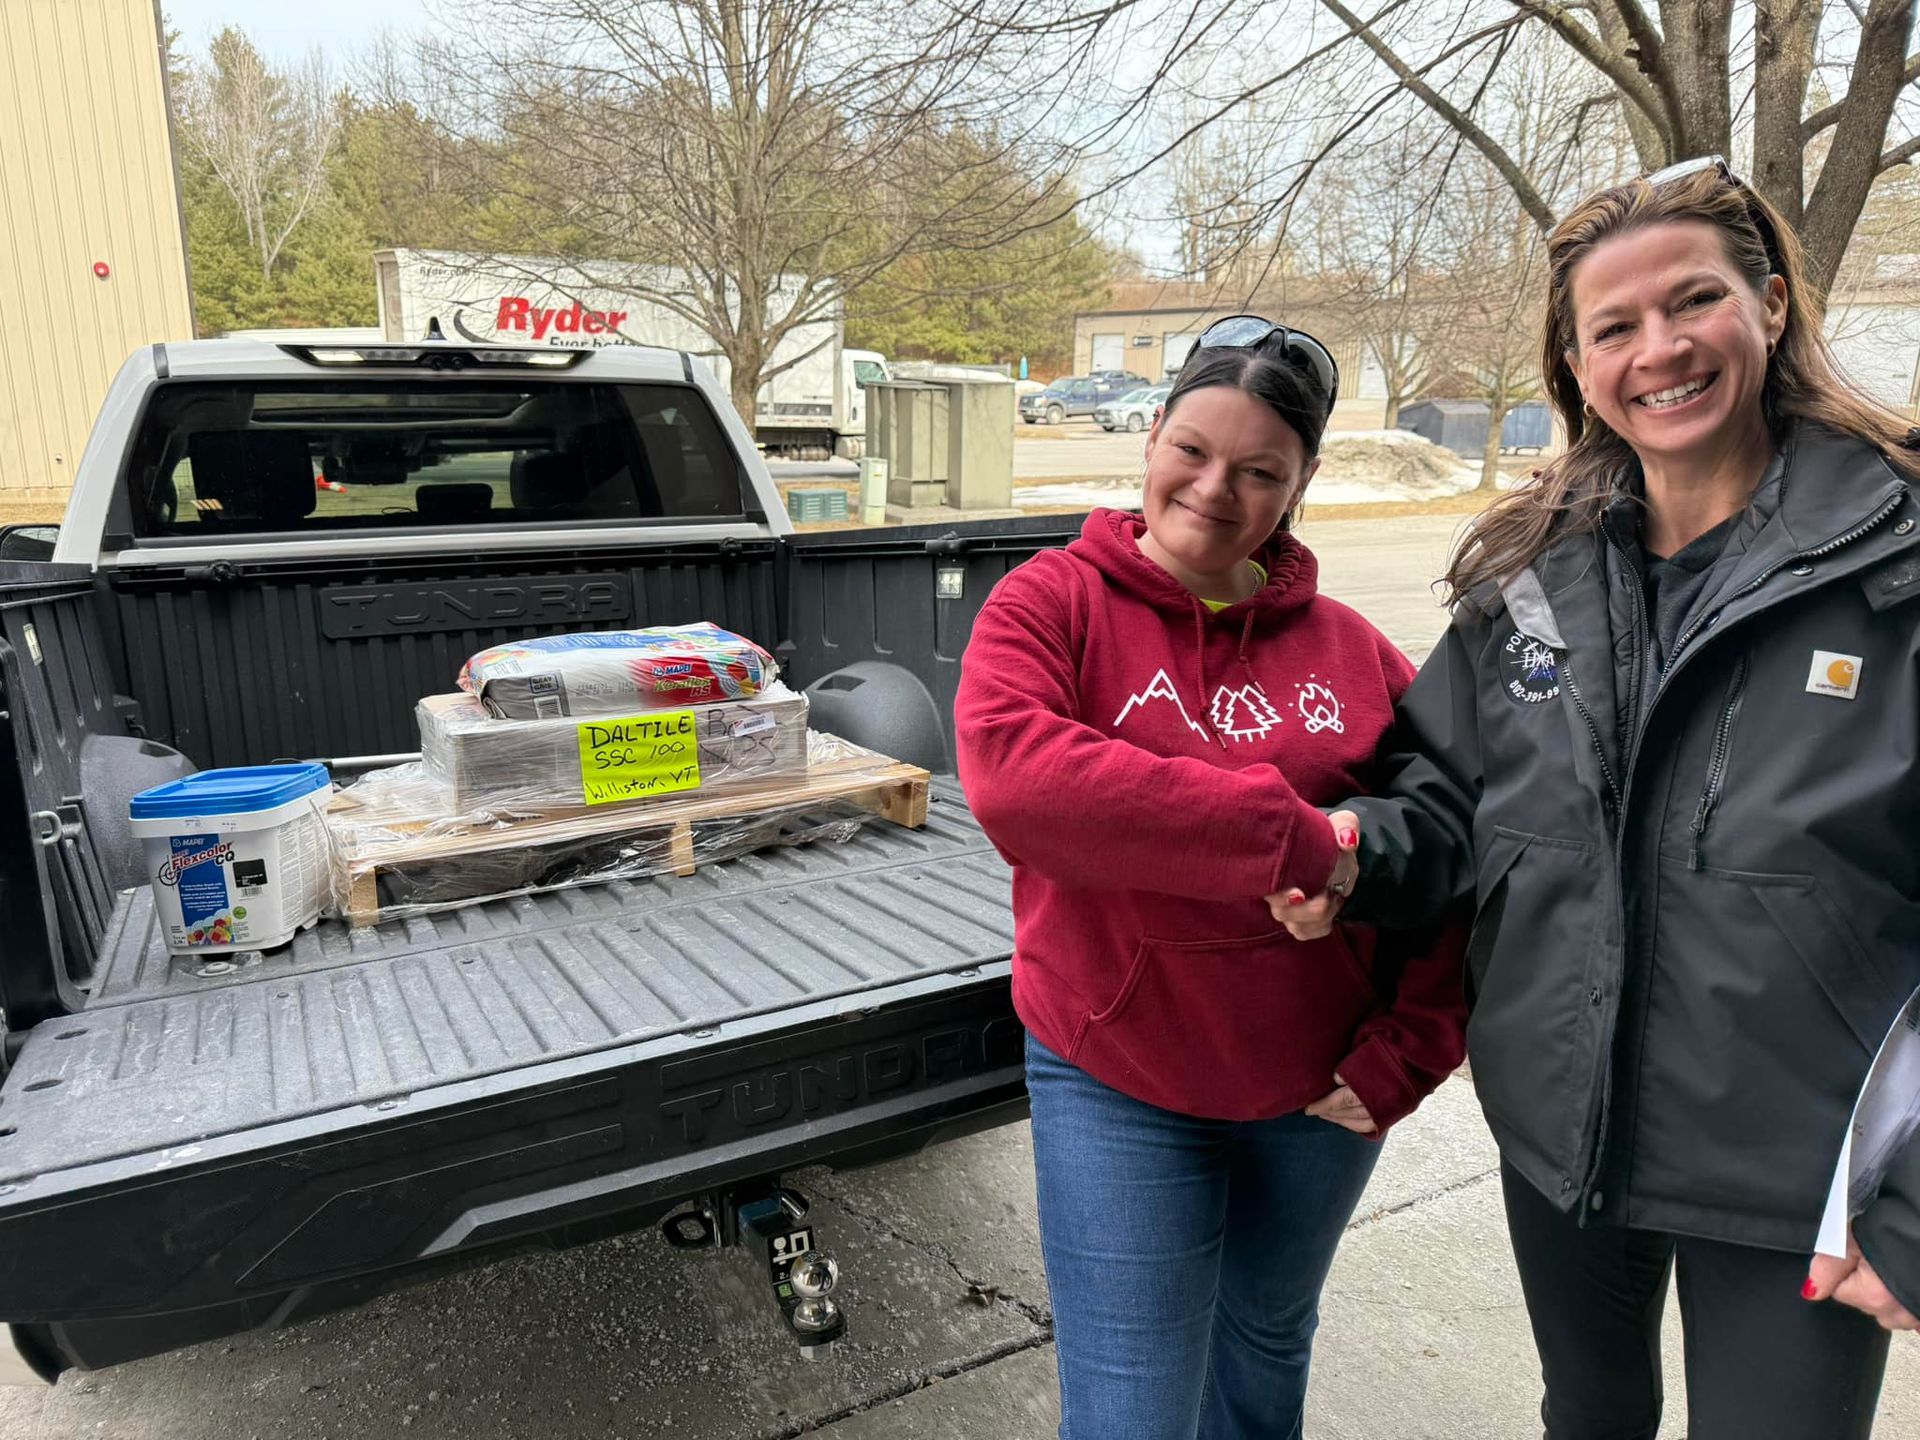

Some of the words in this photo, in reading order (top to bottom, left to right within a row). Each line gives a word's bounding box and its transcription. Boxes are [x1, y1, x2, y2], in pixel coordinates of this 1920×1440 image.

[497, 297, 627, 339] Ryder
[330, 581, 622, 630] TUNDRA
[666, 664, 692, 675] MAPEI
[586, 716, 691, 749] DALTILE
[595, 748, 637, 769] SSC
[650, 741, 685, 759] 100
[669, 765, 697, 784] VT
[172, 841, 232, 871] Flexcolor
[215, 851, 236, 865] CQ
